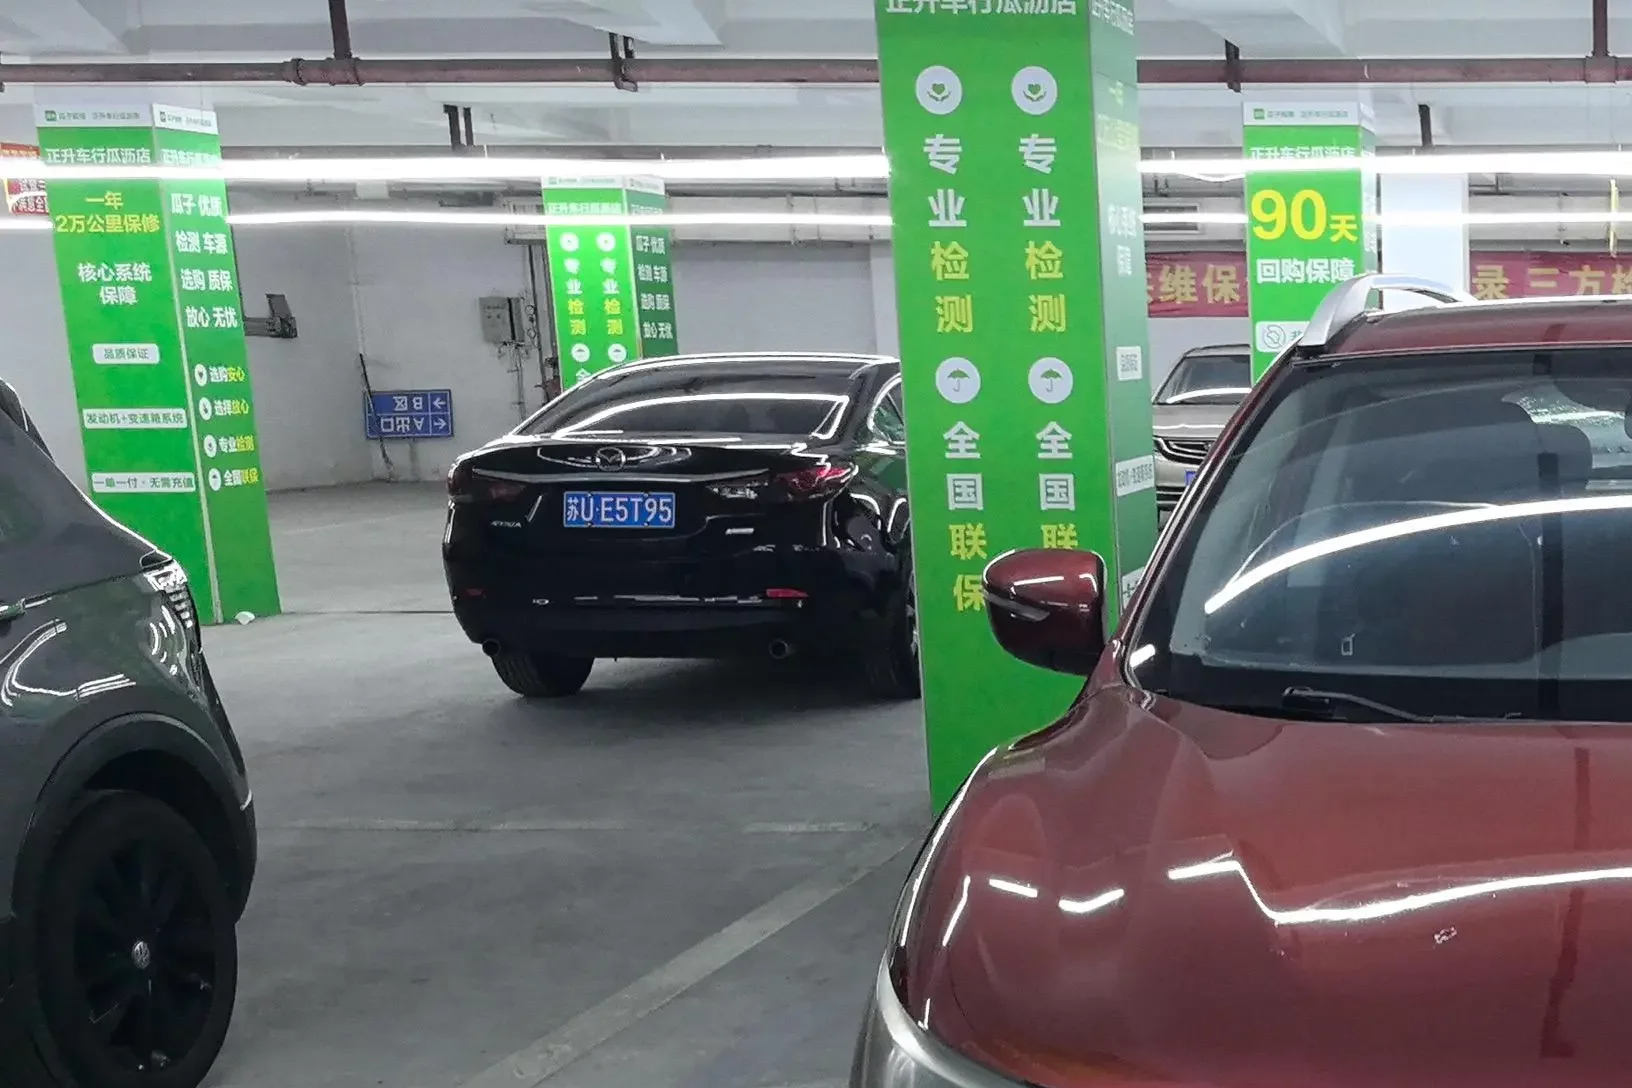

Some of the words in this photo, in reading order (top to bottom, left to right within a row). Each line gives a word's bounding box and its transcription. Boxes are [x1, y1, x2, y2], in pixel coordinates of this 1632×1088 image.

[85, 191, 124, 209] 一年
[56, 214, 161, 234] 2万公里保修
[1251, 189, 1358, 243] 90天
[922, 133, 975, 333] 专业检测
[1018, 133, 1067, 333] 专业检测
[77, 262, 153, 283] 核心系统
[1147, 264, 1240, 303] 维保
[1256, 258, 1356, 284] 回购保障
[99, 286, 138, 306] 保障
[185, 306, 210, 328] 放心
[103, 347, 150, 360] 品质保证
[1035, 420, 1079, 549] 全国联
[942, 420, 988, 612] 全国联保
